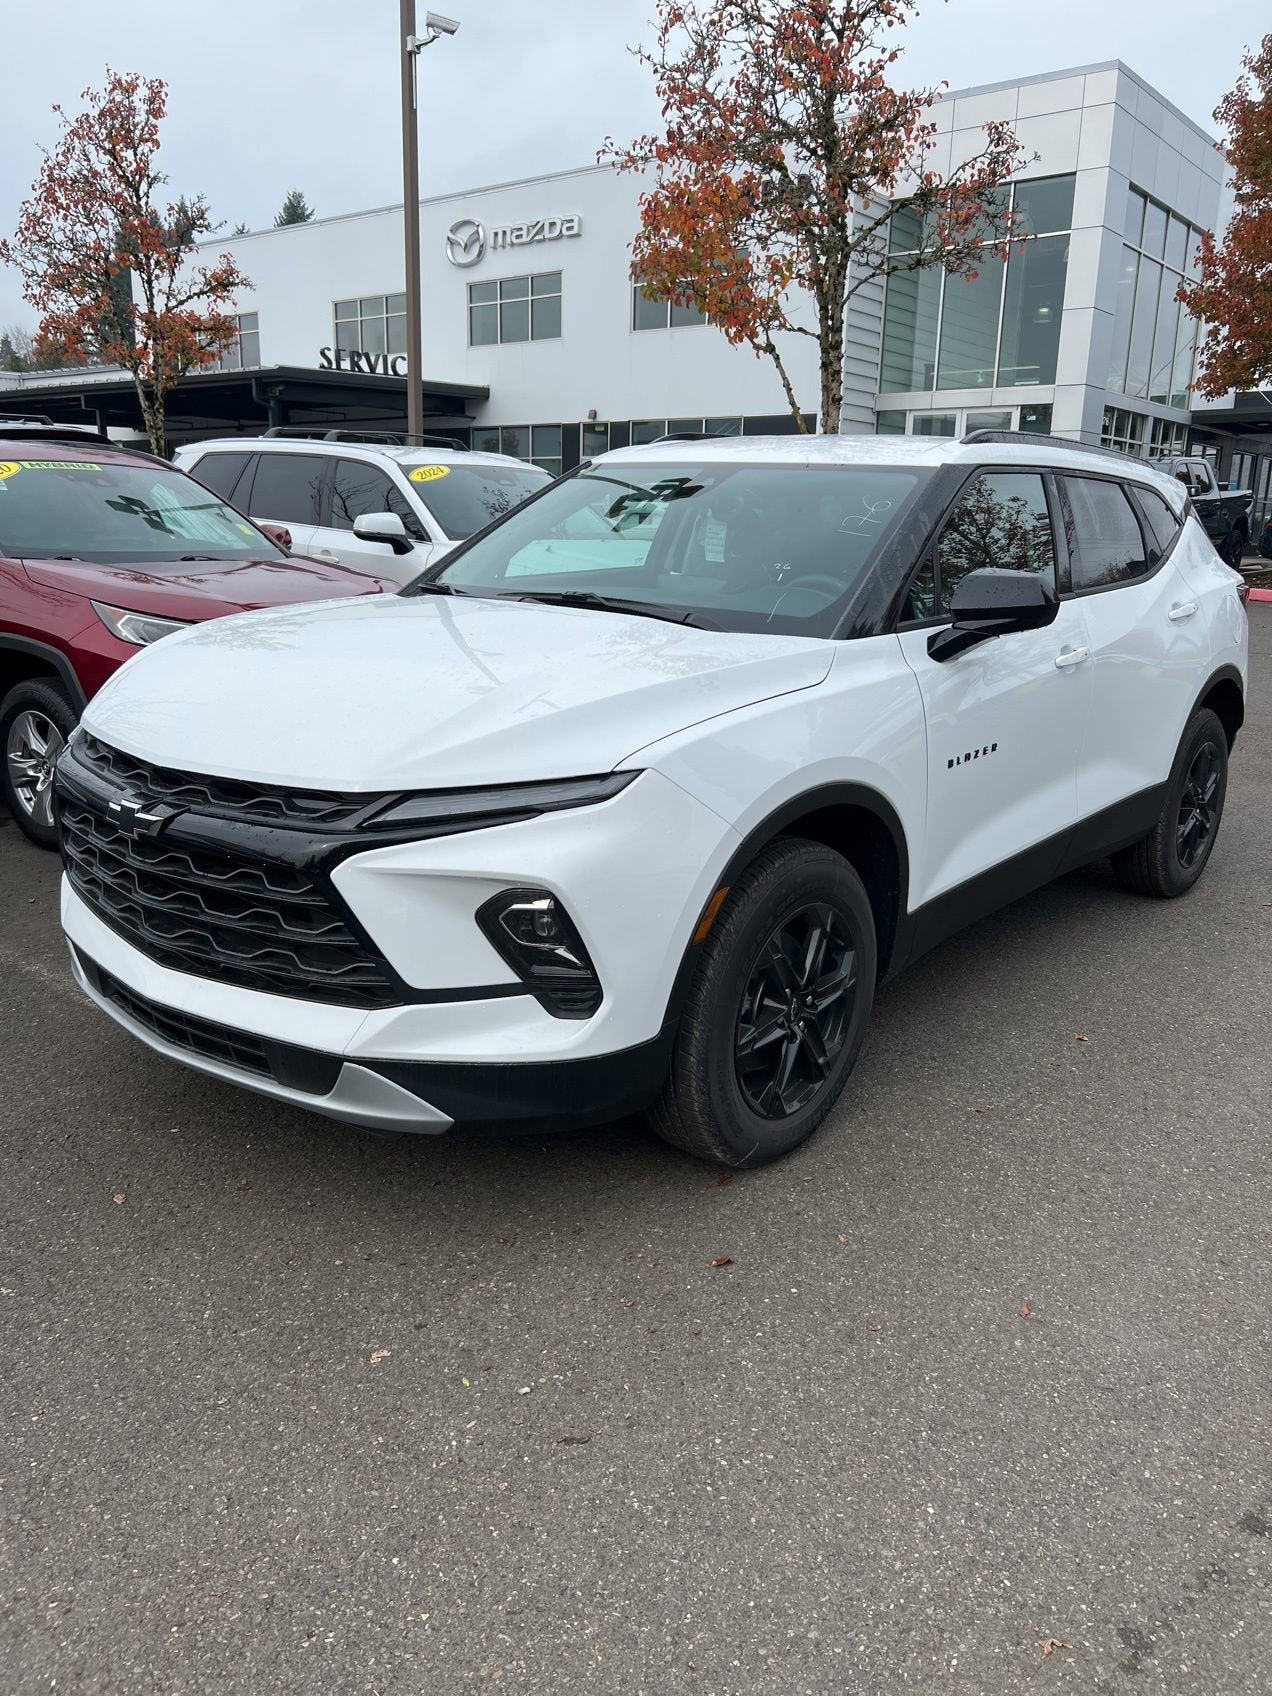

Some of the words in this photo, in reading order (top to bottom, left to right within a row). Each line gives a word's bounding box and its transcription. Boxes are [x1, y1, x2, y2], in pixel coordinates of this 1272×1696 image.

[490, 214, 582, 250] mazda
[319, 346, 408, 377] SERVIC
[28, 462, 94, 470] HYBRID
[416, 466, 445, 480] 2024
[947, 742, 998, 769] BLAZER
